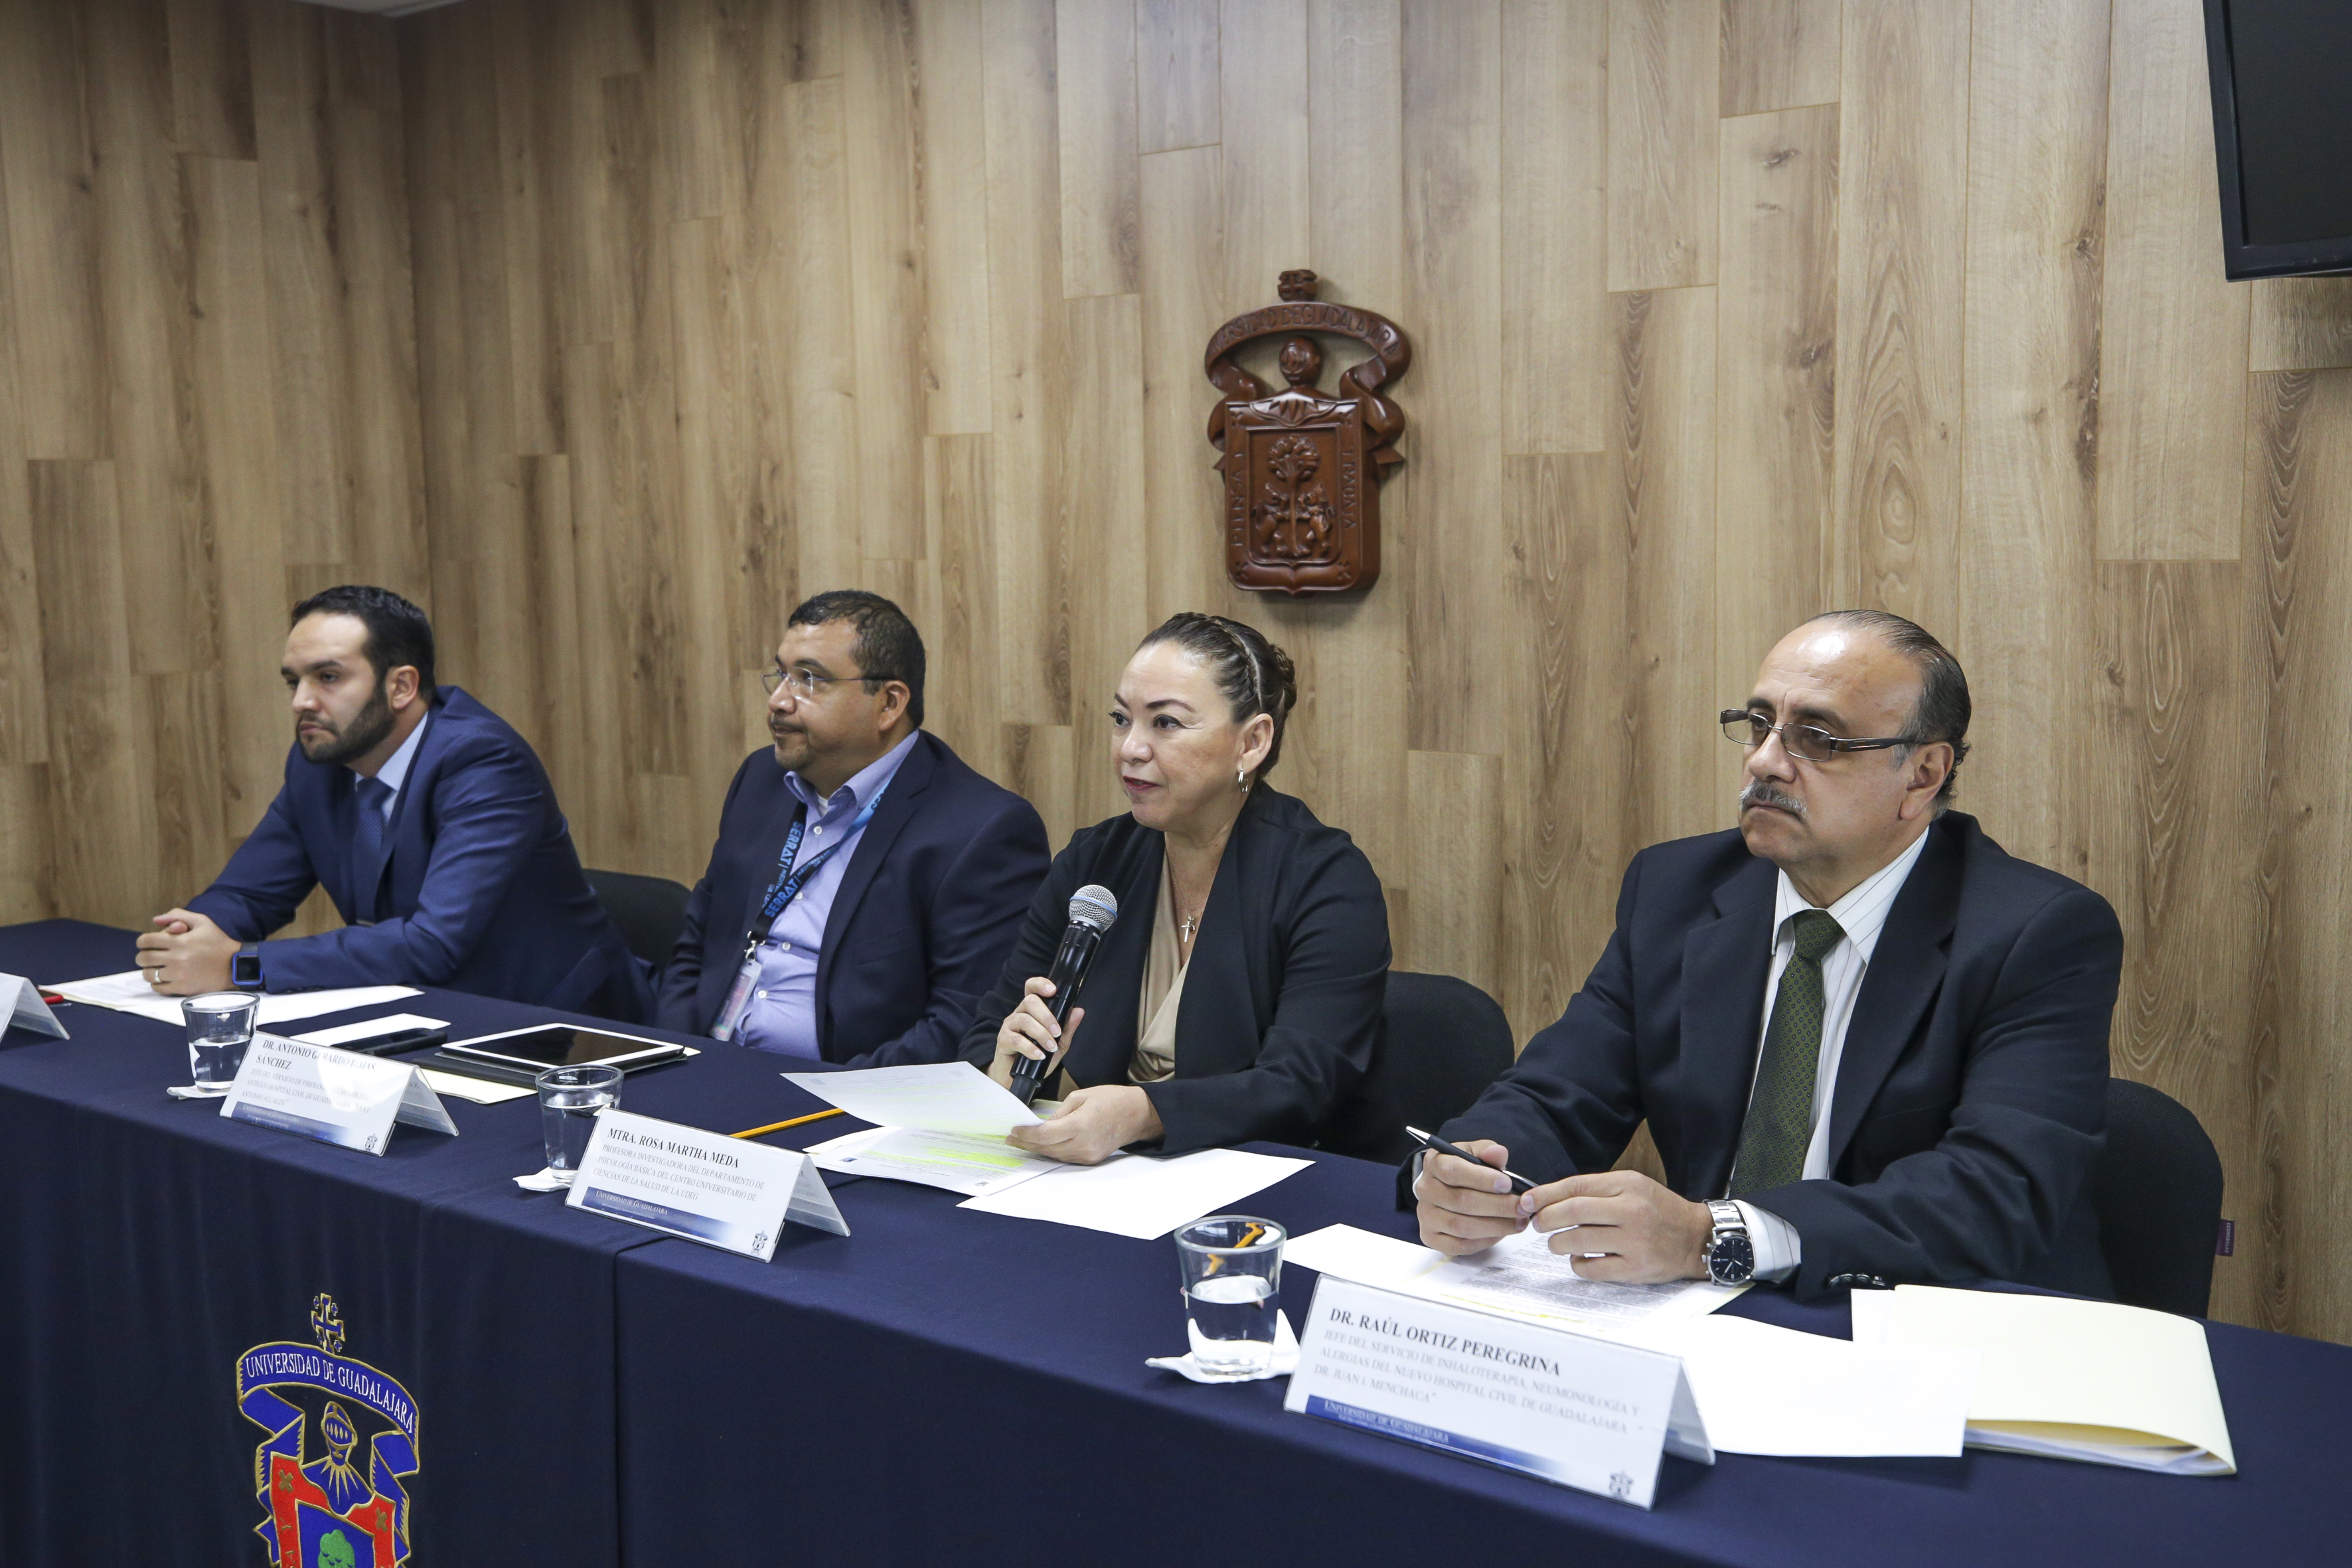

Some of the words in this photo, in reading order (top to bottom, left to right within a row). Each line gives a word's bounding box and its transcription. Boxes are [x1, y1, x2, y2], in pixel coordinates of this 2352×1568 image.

[764, 878, 799, 918] SERRAT
[256, 1053, 292, 1070] SÁNCHEZ
[263, 1040, 274, 1050] DR.
[275, 1043, 311, 1058] ANTONIO
[273, 1073, 295, 1084] SERVICIO
[602, 1144, 637, 1159] PROFESORA
[637, 1152, 687, 1171] INVESTIGADORA
[688, 1164, 700, 1174] DEL
[701, 1167, 755, 1188] DEPARTAMENTO
[755, 1181, 765, 1190] DE
[607, 1128, 637, 1144] MTRA.
[639, 1135, 664, 1150] ROSA
[665, 1141, 708, 1160] MARTHA
[709, 1152, 739, 1168] MEDA
[593, 1167, 621, 1181] CIENCIAS
[621, 1174, 630, 1184] DE
[630, 1176, 638, 1186] LA
[639, 1179, 661, 1191] SALUD
[661, 1185, 670, 1195] DE
[670, 1187, 680, 1196] LA
[680, 1189, 699, 1201] UDEG
[597, 1156, 633, 1171] PSICOLOGÍA
[633, 1163, 655, 1177] BÁSICA
[657, 1170, 670, 1180] DEL
[670, 1173, 696, 1186] CENTRO
[696, 1180, 747, 1200] UNIVERSITARIO
[747, 1192, 757, 1202] DE
[1324, 1329, 1346, 1344] JEFE
[1348, 1334, 1368, 1349] DEL
[1372, 1340, 1420, 1361] SERVICIO
[1421, 1353, 1437, 1366] DE
[1330, 1306, 1354, 1326] DR.
[1360, 1314, 1402, 1338] RAÚL
[1407, 1326, 1458, 1351] ORTIZ
[1461, 1338, 1560, 1376] PEREGRINA
[245, 1352, 321, 1377] UNIVERSIDAD
[323, 1360, 335, 1383] DE
[337, 1366, 414, 1433] GUADALAJARA
[1318, 1346, 1370, 1368] ALERGIAS
[1372, 1358, 1391, 1373] DEL
[1394, 1364, 1433, 1383] NUEVO
[1433, 1373, 1488, 1397] HOSPITAL
[1488, 1388, 1518, 1407] CIVIL
[1521, 1396, 1537, 1410] DE
[1539, 1402, 1628, 1434] GUADALAJARA
[1332, 1368, 1359, 1385] JUAN
